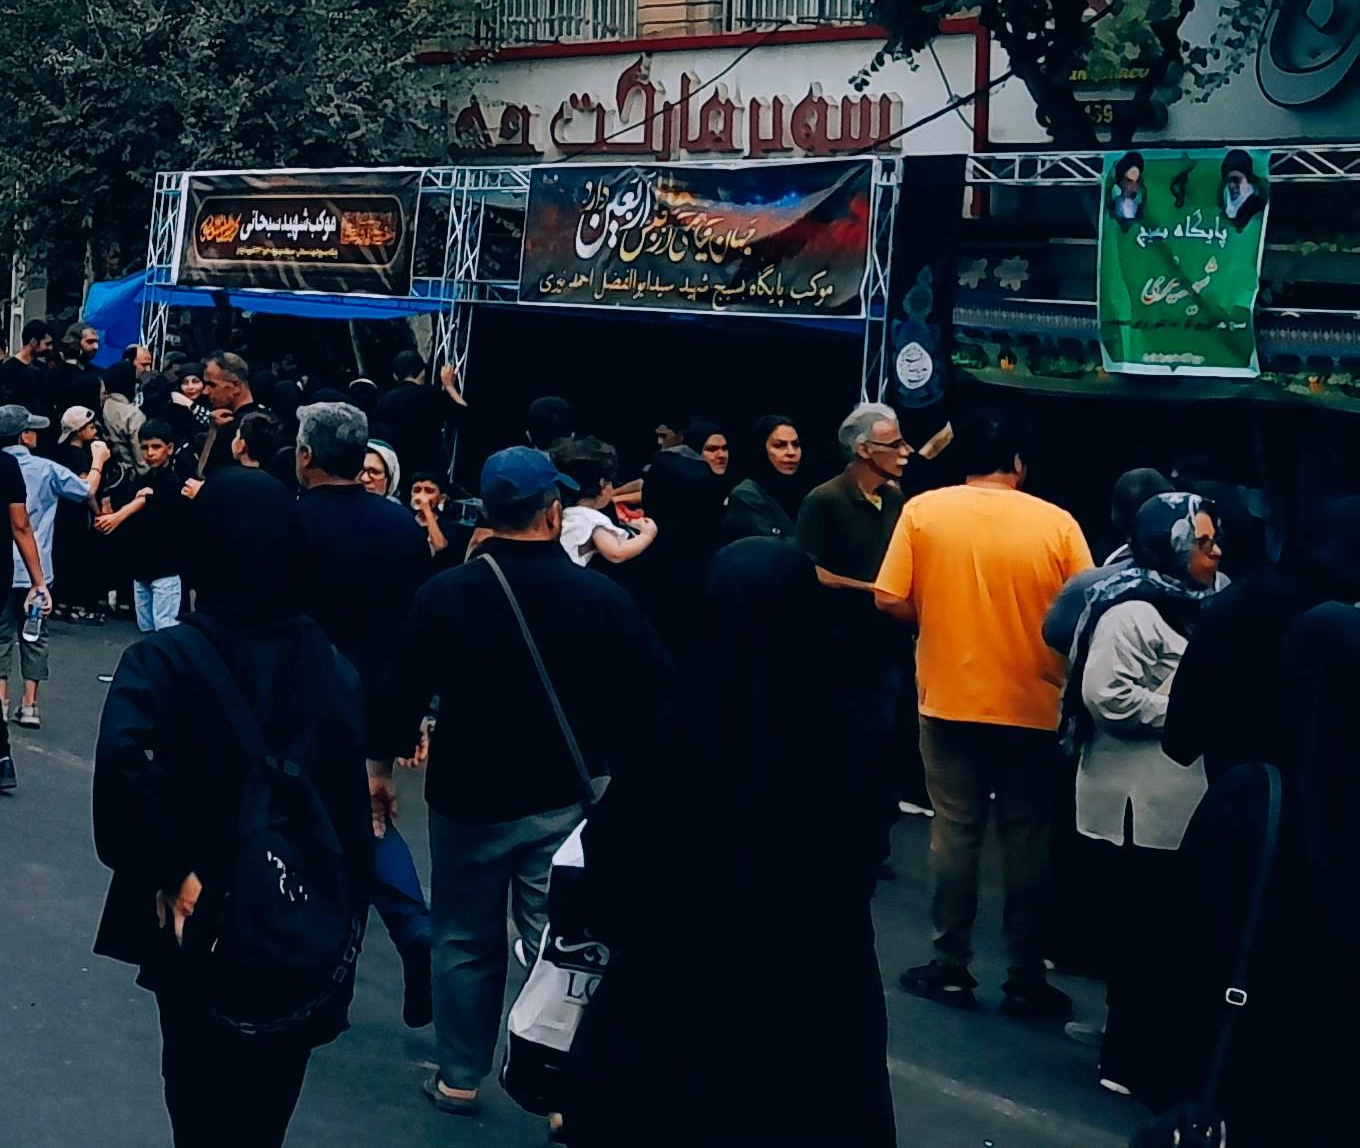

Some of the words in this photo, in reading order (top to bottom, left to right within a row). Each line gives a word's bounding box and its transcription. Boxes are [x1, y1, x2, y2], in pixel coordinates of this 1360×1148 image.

[575, 172, 657, 260] اربعین
[1173, 208, 1228, 248] پایگاه
[678, 272, 709, 301] شهید
[712, 278, 746, 311] بسیج
[749, 264, 785, 308] پایگاه
[790, 270, 833, 306] موکب
